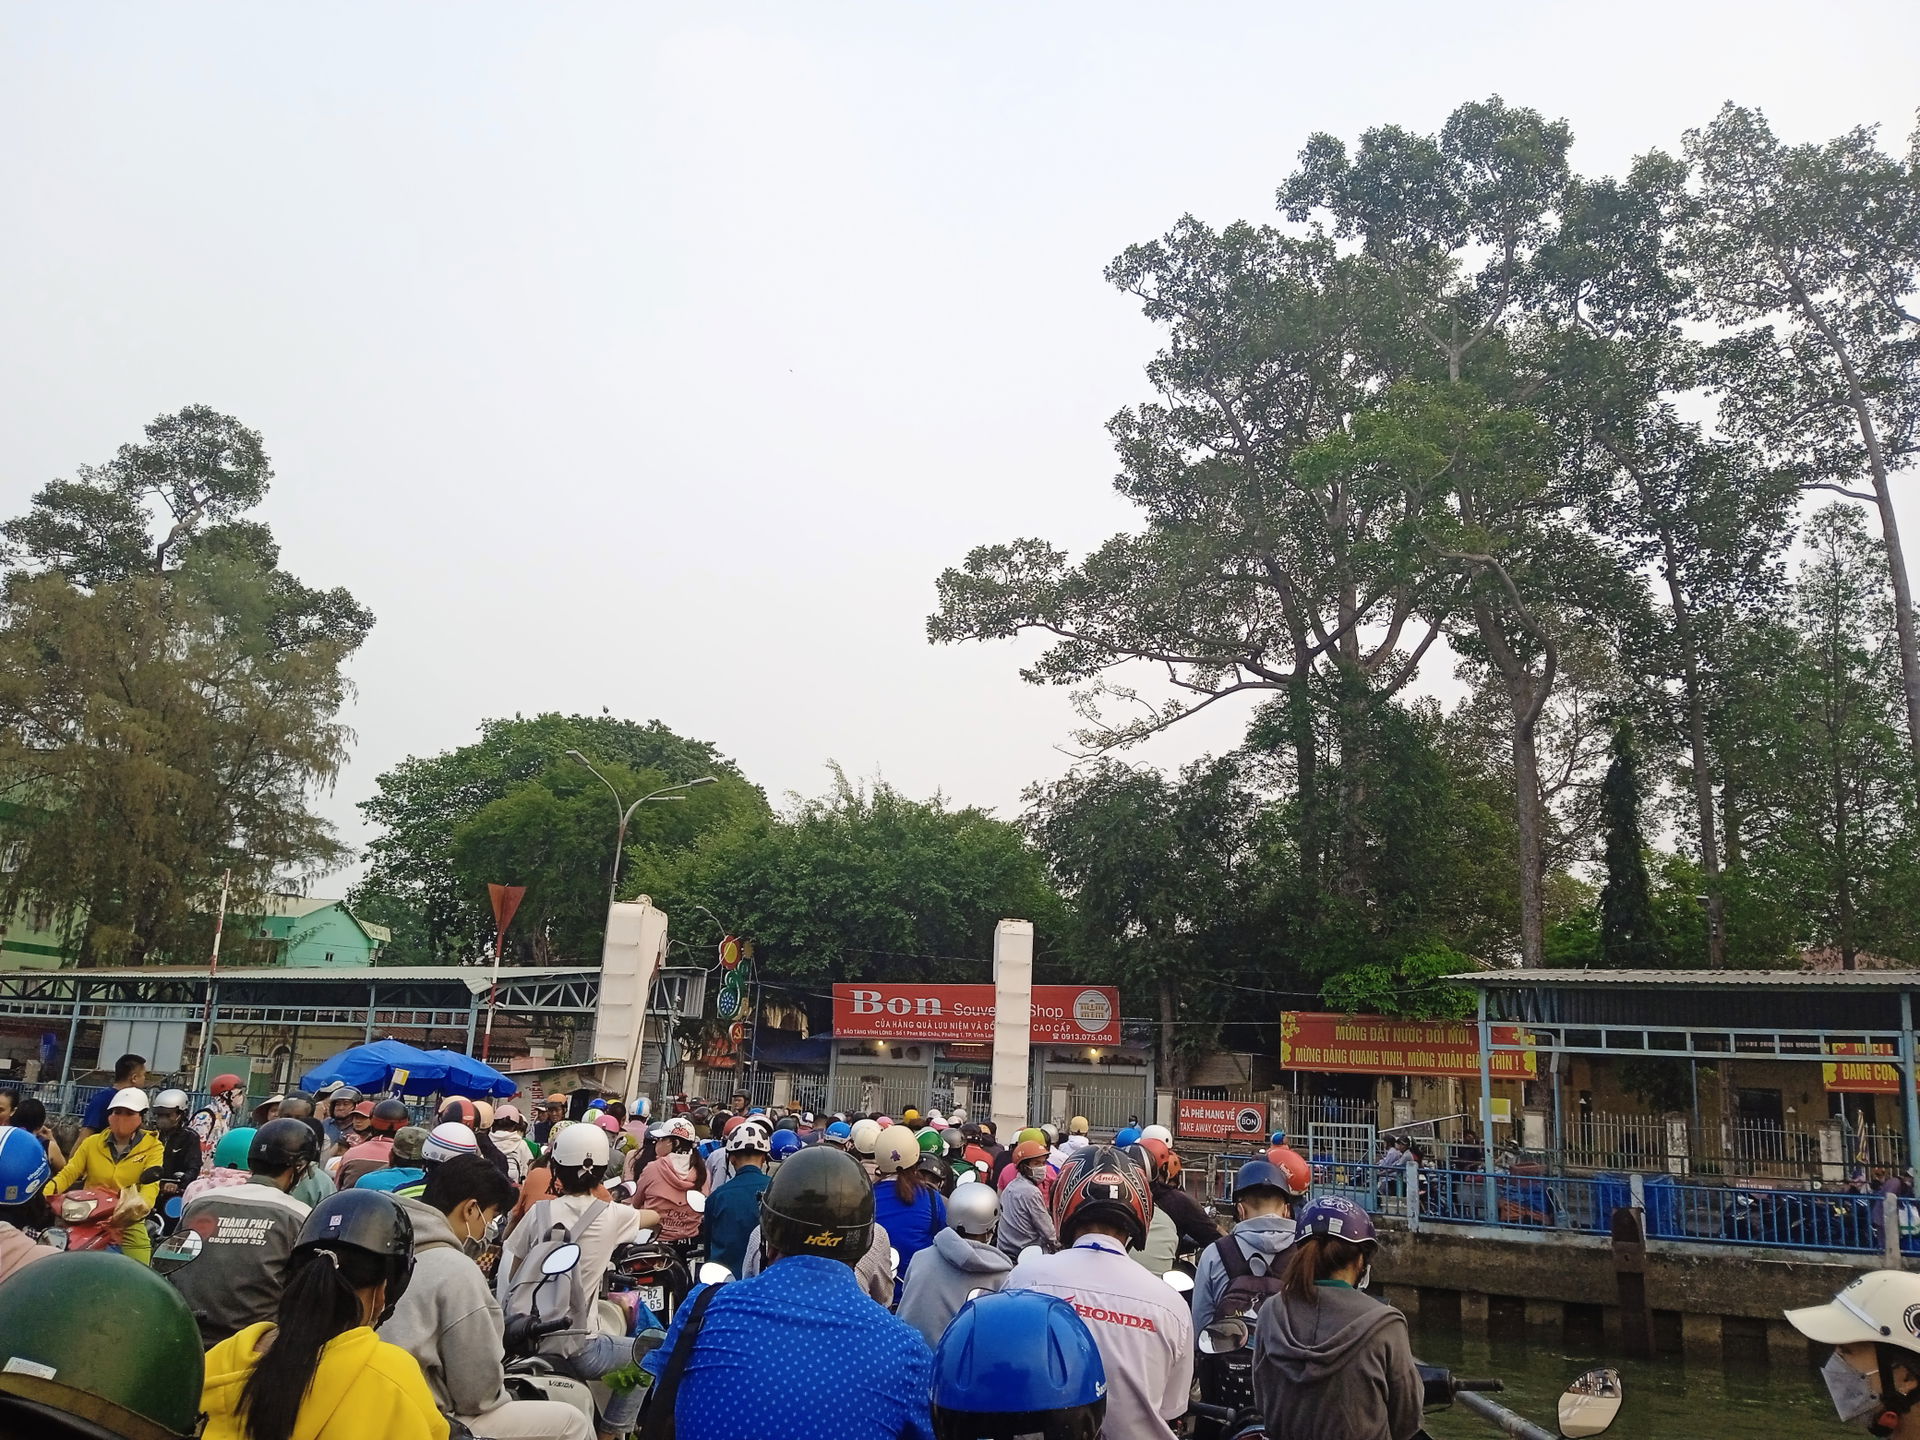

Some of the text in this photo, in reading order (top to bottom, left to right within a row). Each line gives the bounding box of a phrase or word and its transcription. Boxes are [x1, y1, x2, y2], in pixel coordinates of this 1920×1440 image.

[849, 989, 1064, 1021] Bon Souve Shop
[892, 1018, 914, 1029] HÀNG
[1033, 1024, 1051, 1032] CAO
[1053, 1021, 1071, 1032] CẤP
[1060, 1033, 1113, 1041] 0913.075.040
[1335, 1023, 1367, 1041] MỪNG
[1369, 1022, 1390, 1042] ĐẤT
[1393, 1025, 1423, 1044] NƯỚC
[1295, 1044, 1321, 1062] MỪNG
[1323, 1043, 1347, 1064] ĐẢNG
[1349, 1049, 1379, 1066] QUANG
[1381, 1050, 1405, 1068] VINH,
[1407, 1049, 1436, 1068] MỪNG
[1437, 1050, 1463, 1069] XUÂN
[1465, 1051, 1481, 1069] GIÁ
[1491, 1051, 1513, 1071] THÌN
[1180, 1106, 1235, 1120] CÀ PHÊ MANG VỀ
[1180, 1122, 1194, 1132] TAKE
[1195, 1123, 1212, 1132] AWAY
[1241, 1118, 1257, 1126] BON
[217, 1216, 276, 1230] THÀNH PHÁT
[217, 1227, 266, 1239] WINDOWS
[1074, 1303, 1158, 1333] HONDA
